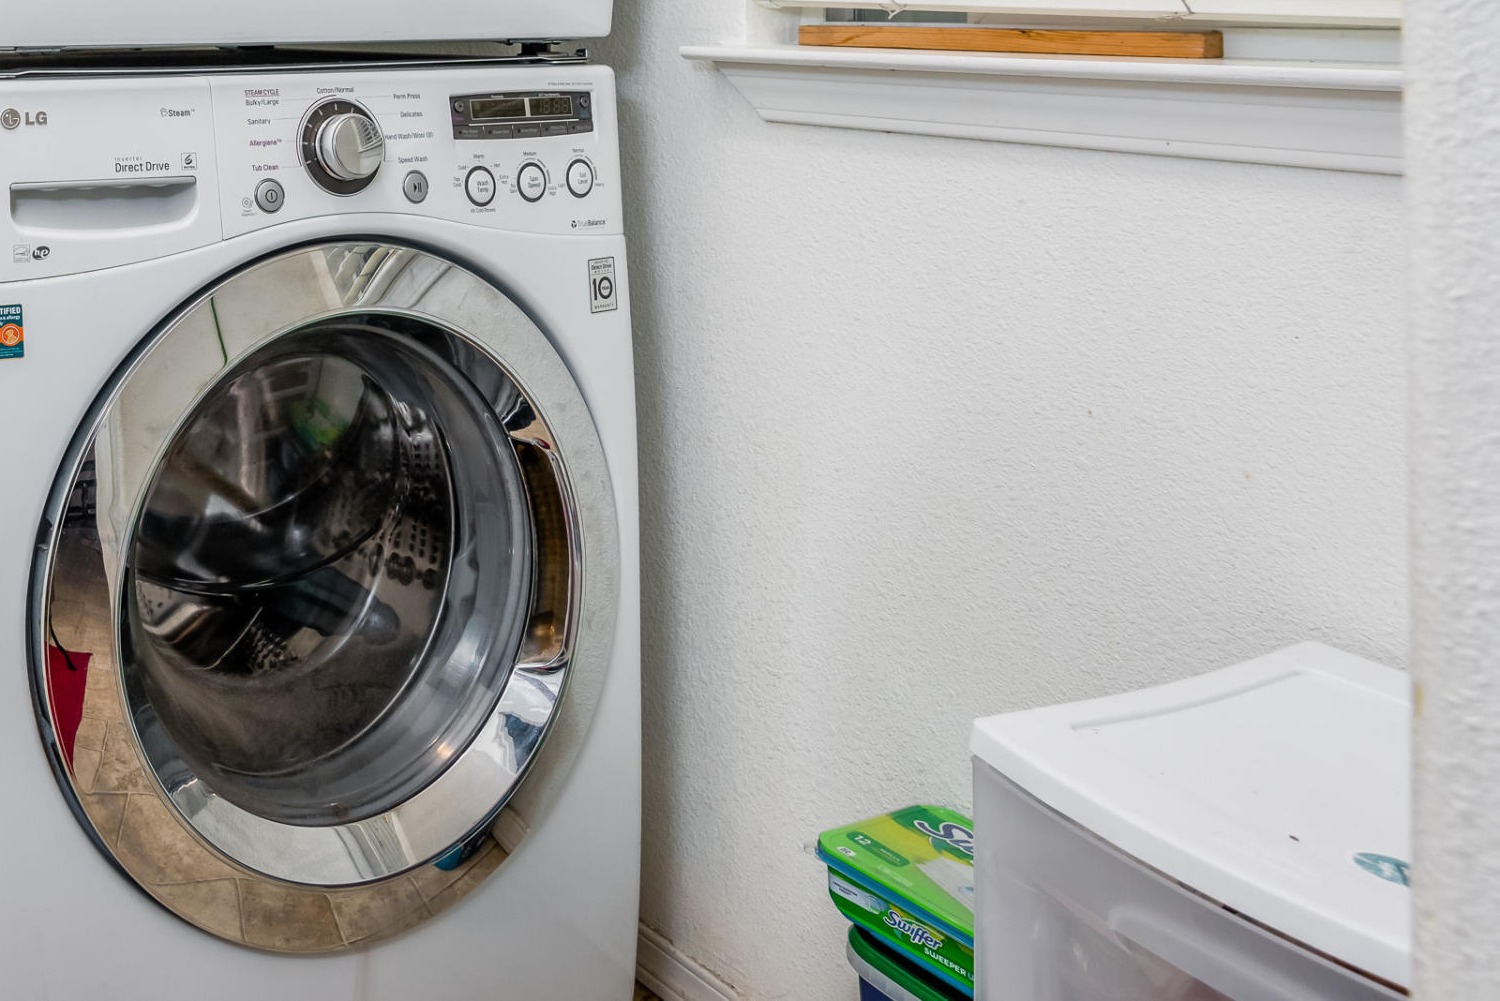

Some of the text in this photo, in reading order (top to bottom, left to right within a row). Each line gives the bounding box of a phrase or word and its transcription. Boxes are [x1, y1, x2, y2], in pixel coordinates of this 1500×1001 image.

[263, 88, 279, 96] CYCLE
[25, 110, 48, 126] LG
[247, 118, 271, 126] Sanitary
[398, 156, 413, 164] Speed
[115, 161, 170, 173] Direct Drive
[252, 164, 262, 172] Tub
[592, 276, 613, 301] 10
[883, 909, 944, 950] Swiffer
[923, 946, 966, 977] SWEEPER
